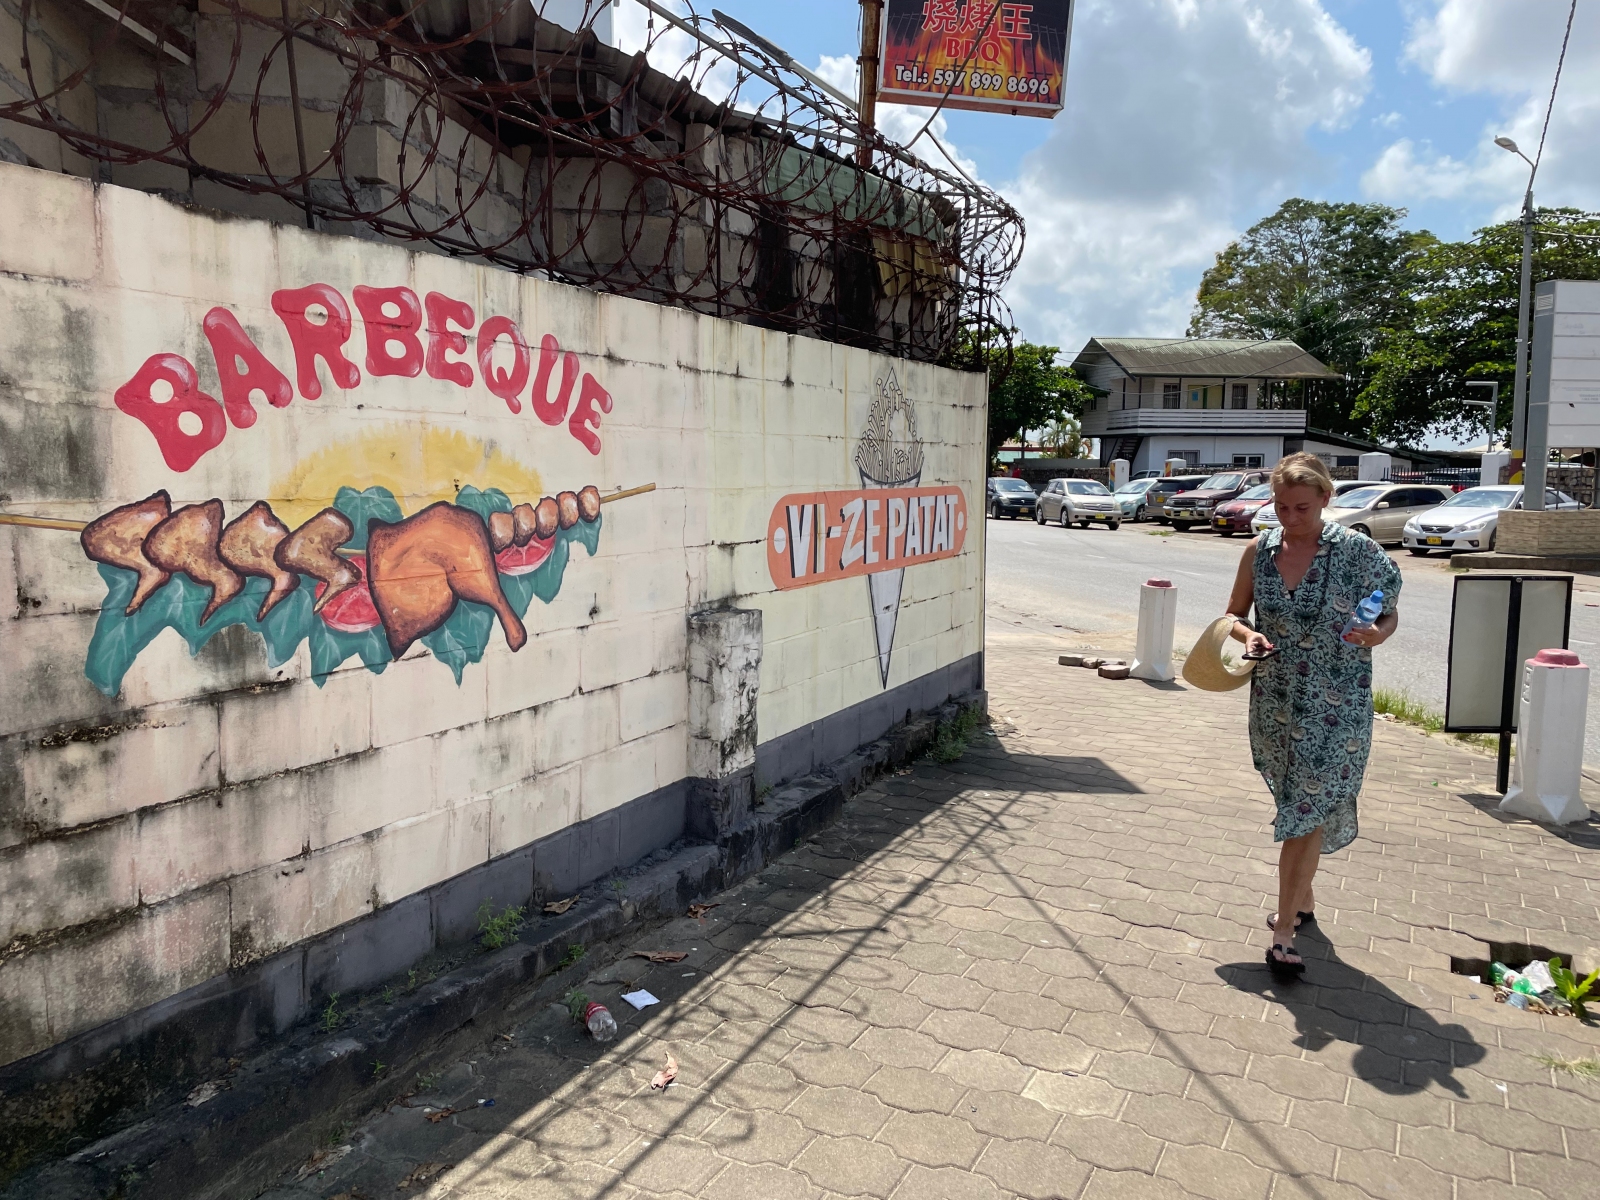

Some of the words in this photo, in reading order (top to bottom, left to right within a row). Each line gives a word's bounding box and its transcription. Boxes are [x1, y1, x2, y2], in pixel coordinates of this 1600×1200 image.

[921, 0, 1033, 40] 烧烤王
[945, 37, 1002, 65] BBQ
[895, 65, 929, 84] Tel.:
[970, 73, 1003, 91] 899
[1007, 77, 1050, 95] 8696
[114, 283, 613, 472] BARBEQUE
[887, 494, 958, 560] PATAT
